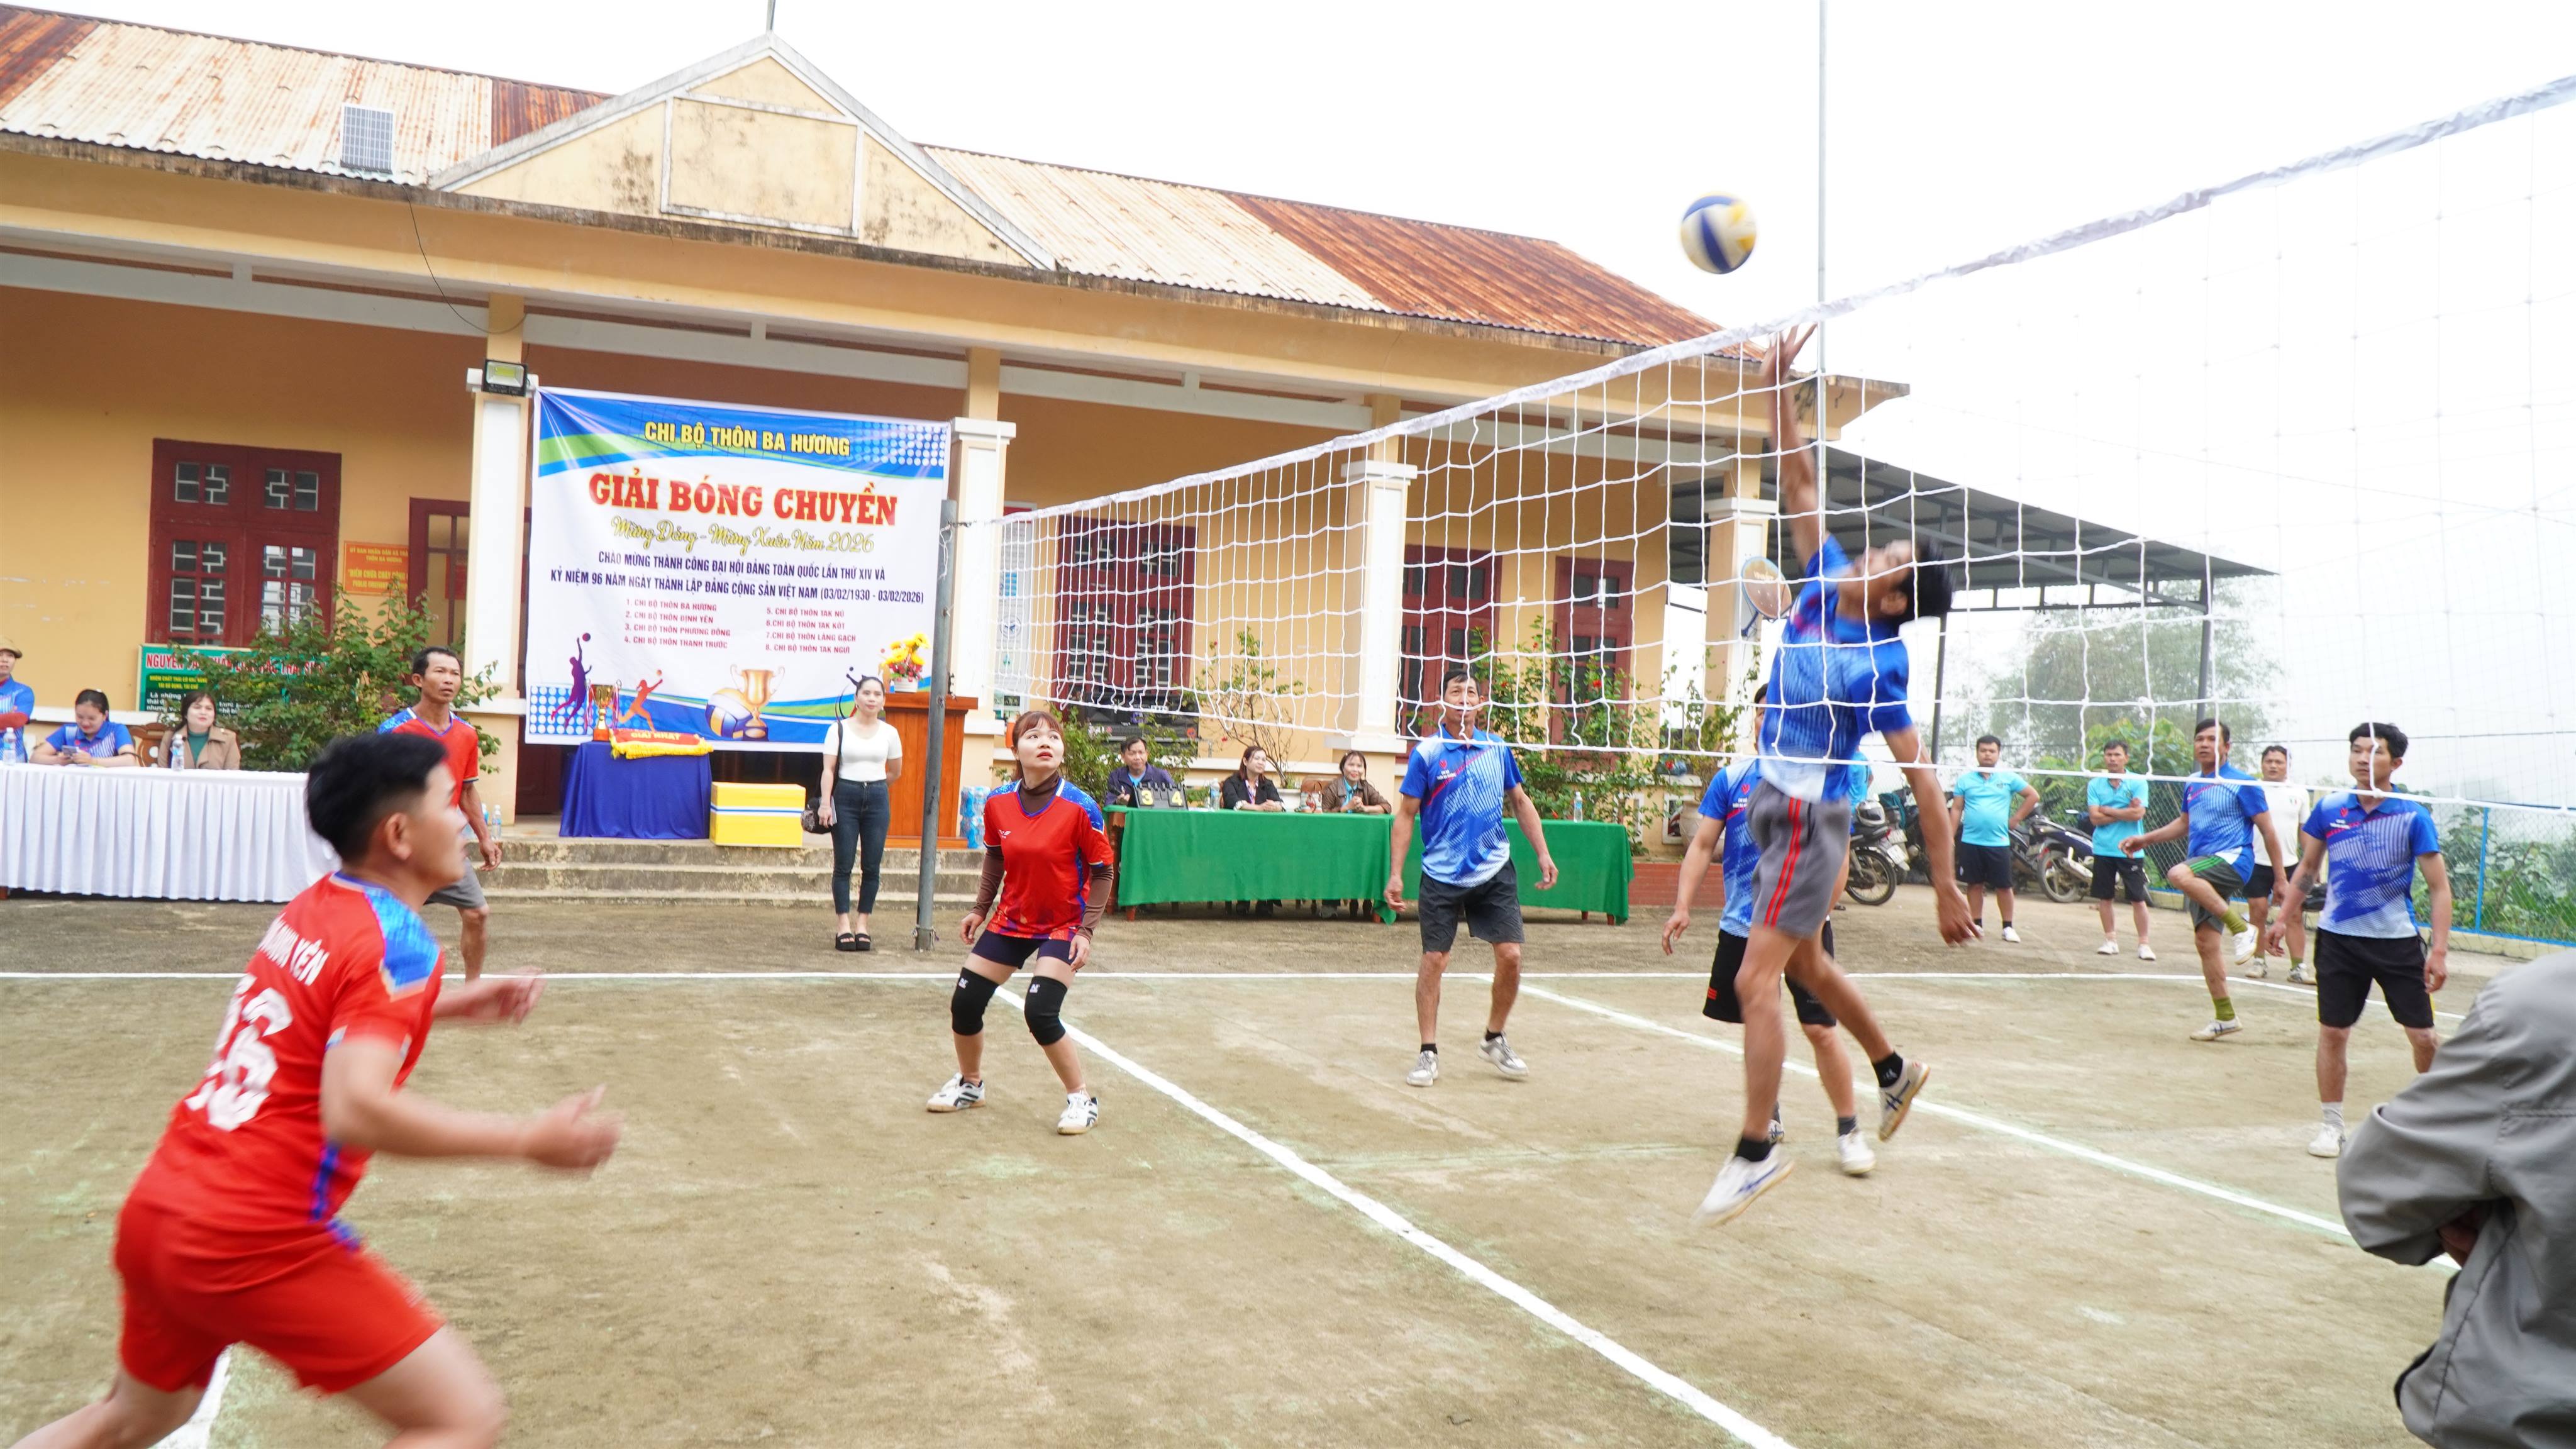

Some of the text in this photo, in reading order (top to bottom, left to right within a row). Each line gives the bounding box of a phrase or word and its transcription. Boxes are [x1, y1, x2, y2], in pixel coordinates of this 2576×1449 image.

[645, 421, 850, 457] CHI BỘ THÔN BA HƯƠNG
[589, 467, 897, 526] GIẢI BÓNG CHUYỀN
[611, 515, 655, 550] Mừng
[656, 519, 697, 553] Đảng
[709, 523, 752, 556] Mừng
[752, 526, 791, 548] Xuân
[791, 529, 825, 552] Năm
[826, 531, 874, 553] 2026
[625, 552, 650, 567] MỪNG
[654, 554, 682, 570] THÀNH
[686, 556, 709, 572] CÔNG
[712, 560, 726, 575] ĐẠI
[730, 558, 743, 576] HỘI
[747, 558, 770, 575] ĐẢNG
[773, 561, 794, 576] TOÀN
[797, 561, 819, 578] QUỐC
[859, 569, 872, 580] XIV
[875, 566, 886, 580] VÀ
[565, 568, 589, 586] NIỆM
[592, 572, 602, 585] 96
[629, 574, 651, 589] NGÀY
[654, 575, 683, 591] THÀNH
[686, 577, 702, 595] LẬP
[705, 577, 729, 594] ĐẢNG
[732, 580, 755, 597] CỘNG
[758, 580, 775, 596] SẢN
[779, 583, 796, 600] VIỆT
[799, 587, 818, 599] NAM
[1141, 790, 1182, 806] 3 4
